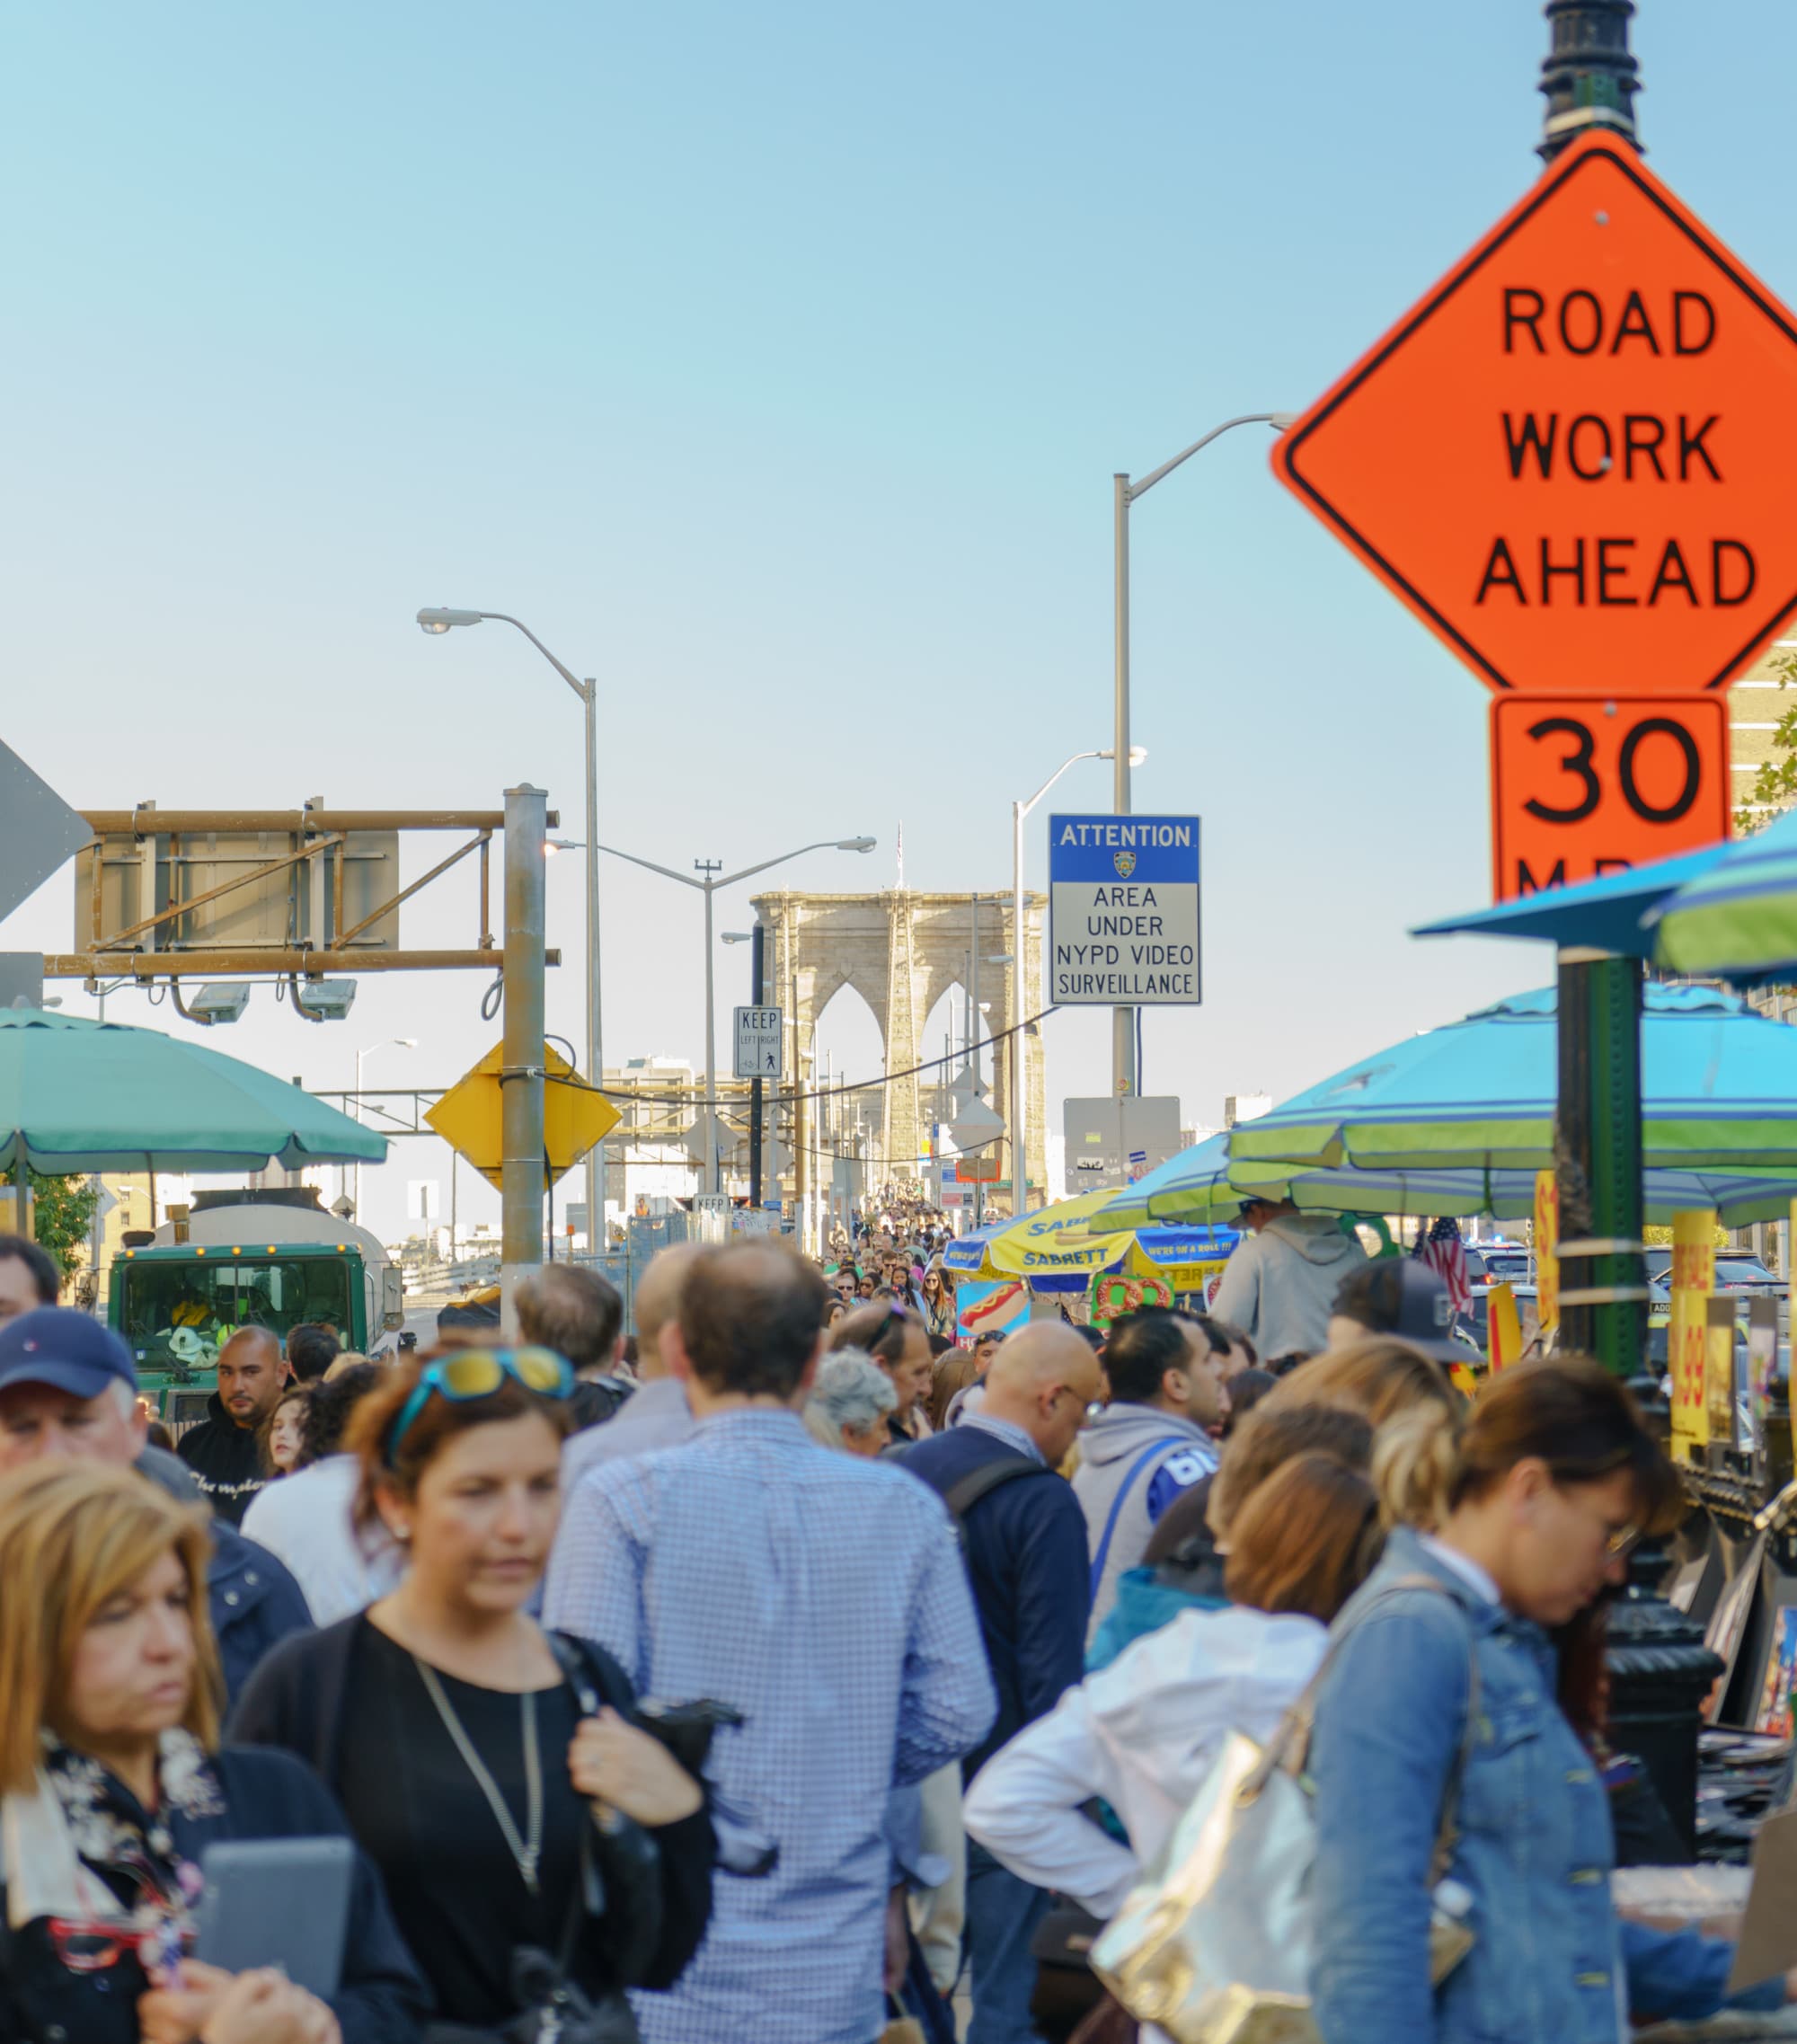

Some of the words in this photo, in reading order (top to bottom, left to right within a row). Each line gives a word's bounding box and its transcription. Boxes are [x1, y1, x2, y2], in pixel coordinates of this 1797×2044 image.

[1502, 288, 1717, 356] ROAD
[1501, 411, 1723, 482] WORK
[1474, 535, 1757, 606] AHEAD
[1523, 717, 1701, 823] 30
[1060, 824, 1191, 846] ATTENTION
[1093, 887, 1157, 907] AREA
[1088, 916, 1163, 935] UNDER
[1058, 945, 1119, 965] NYPD
[1131, 945, 1193, 965] VIDEO
[1058, 974, 1193, 994] SURVEILLANCE
[742, 1012, 776, 1029] KEEP
[740, 1035, 756, 1045] LEFT
[760, 1035, 779, 1045] RIGHT
[1023, 1248, 1108, 1265] SABRETT
[1176, 1245, 1187, 1254] ON
[1199, 1243, 1219, 1252] ROLL
